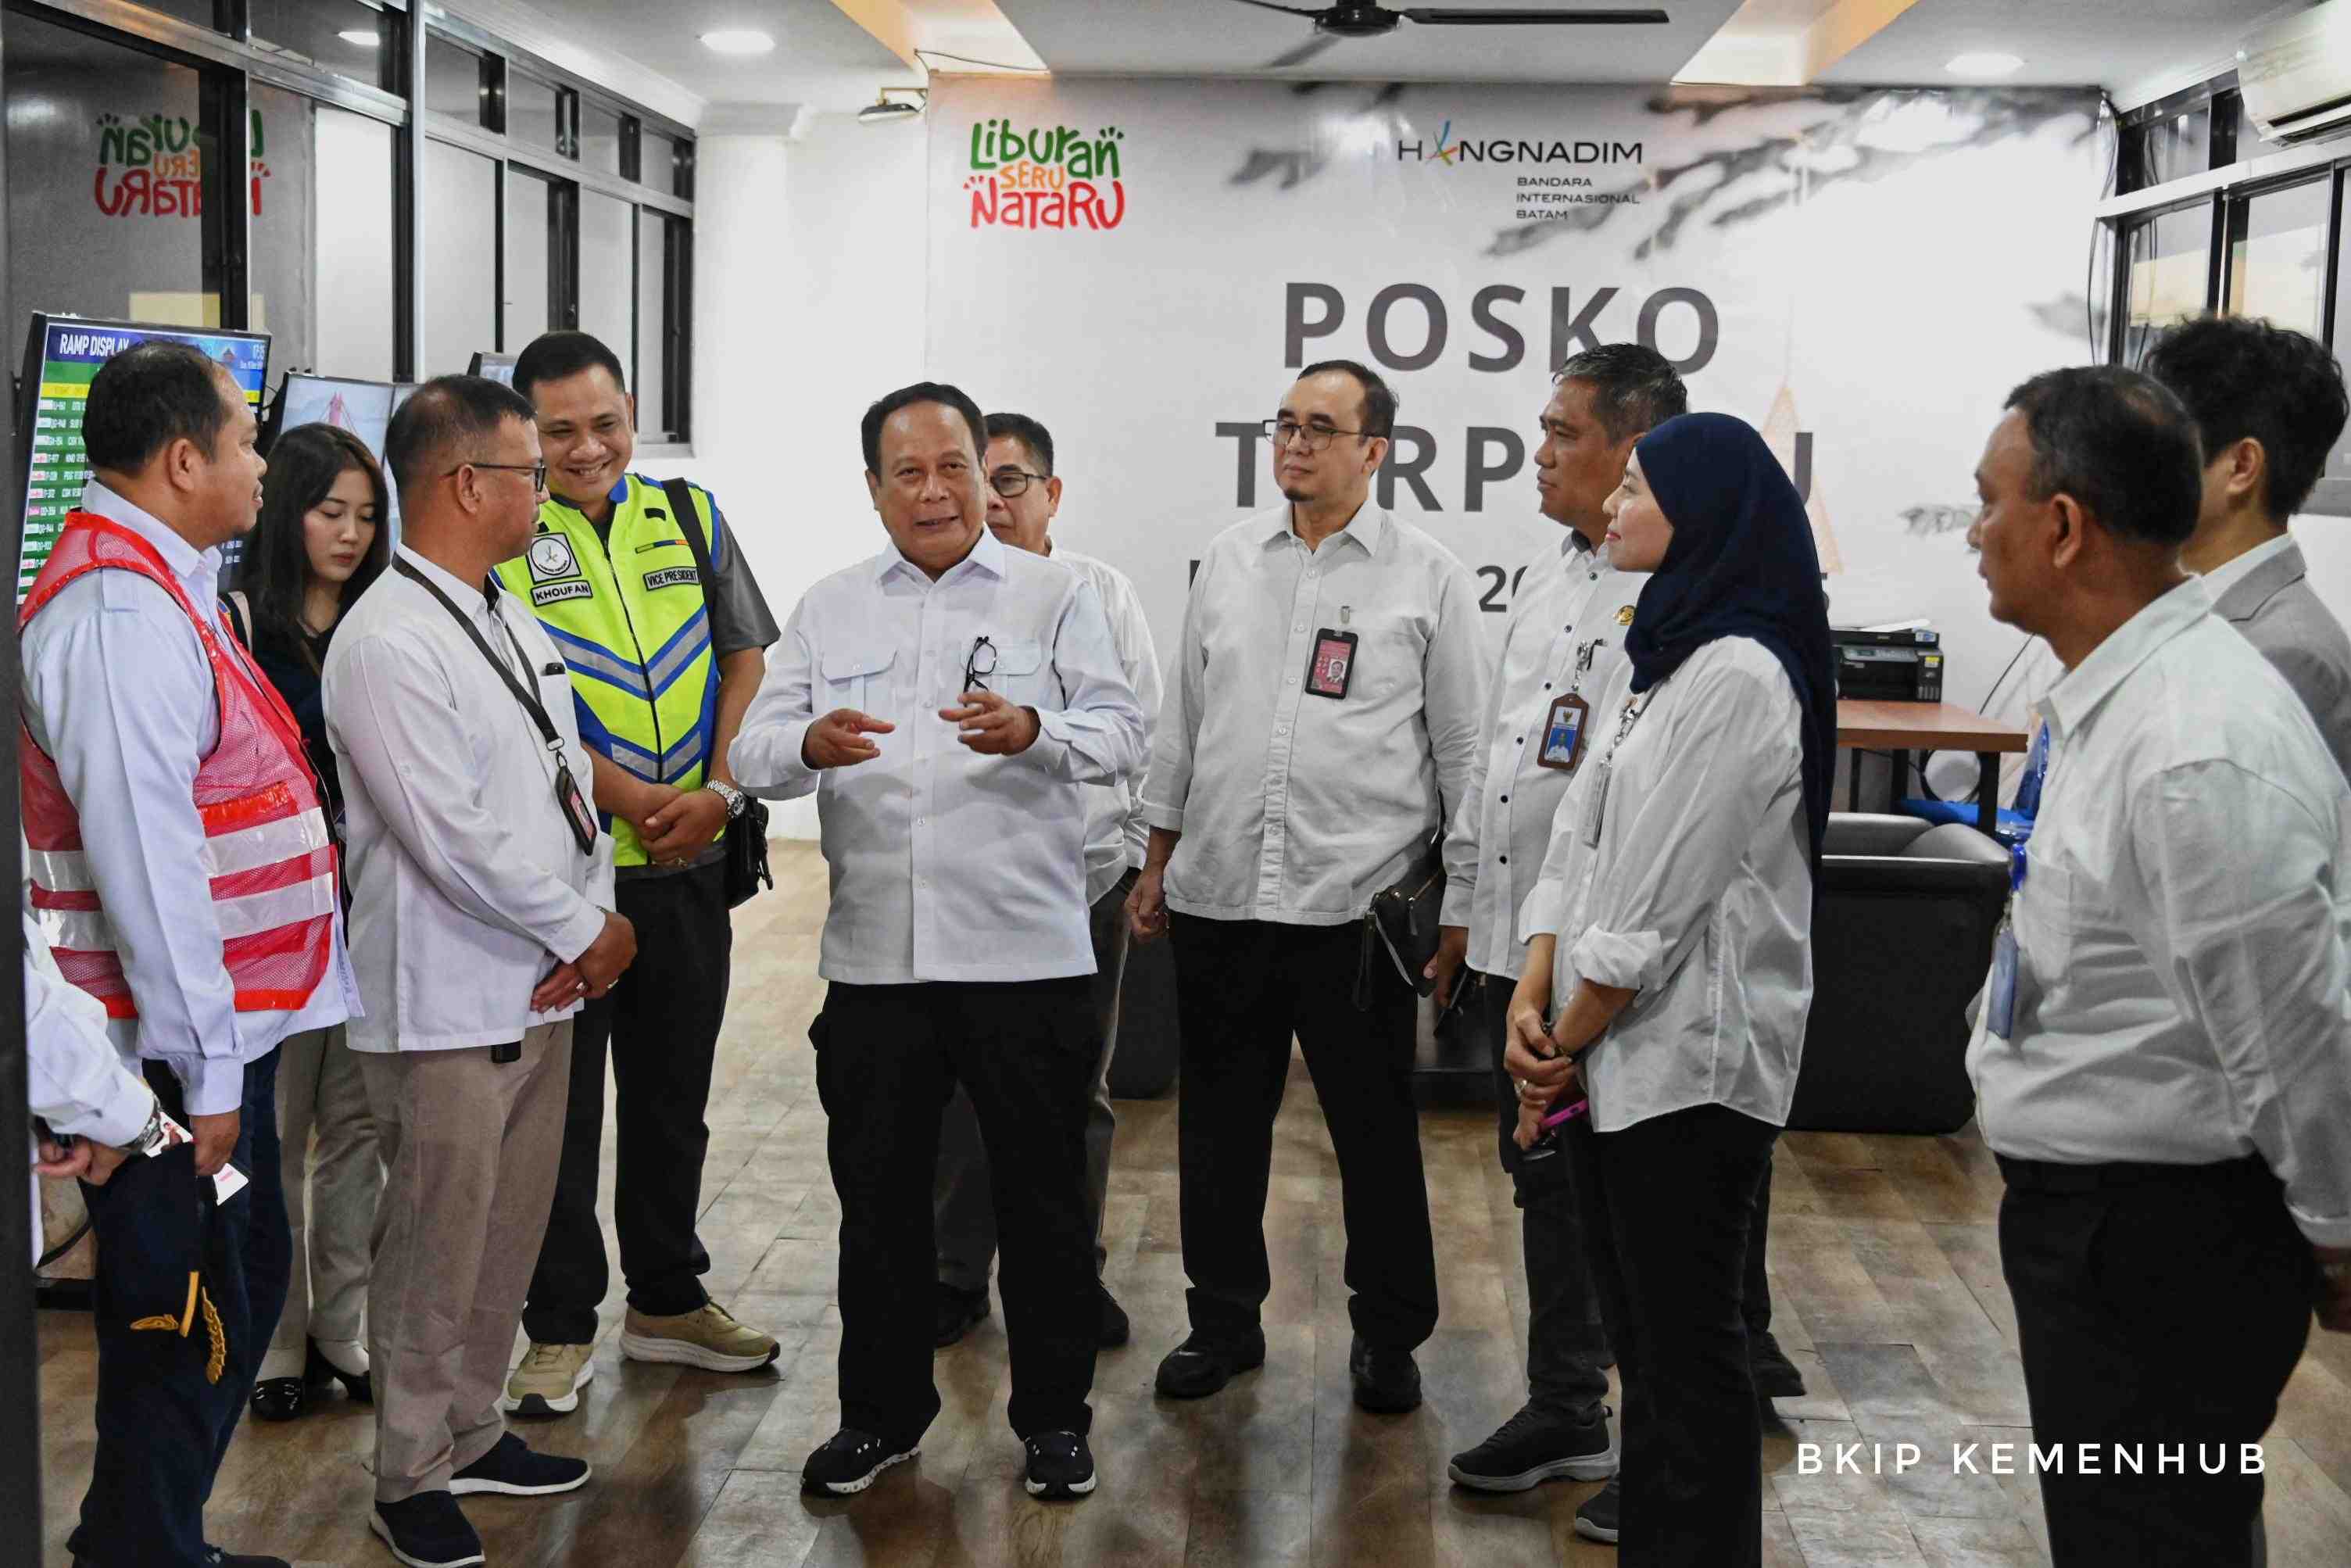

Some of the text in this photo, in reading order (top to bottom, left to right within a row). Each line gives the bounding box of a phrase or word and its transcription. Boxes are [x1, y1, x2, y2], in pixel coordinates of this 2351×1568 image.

[1000, 159, 1065, 192] SERU
[1516, 177, 1593, 188] BANDARA
[1515, 193, 1641, 204] INTERNASIONAL
[1515, 209, 1569, 220] BATAM
[1284, 281, 1719, 374] POSKO
[59, 334, 130, 357] RAMP DISPLAY
[648, 568, 697, 585] VICE PRESIDENT
[535, 585, 589, 601] KHOUFAN
